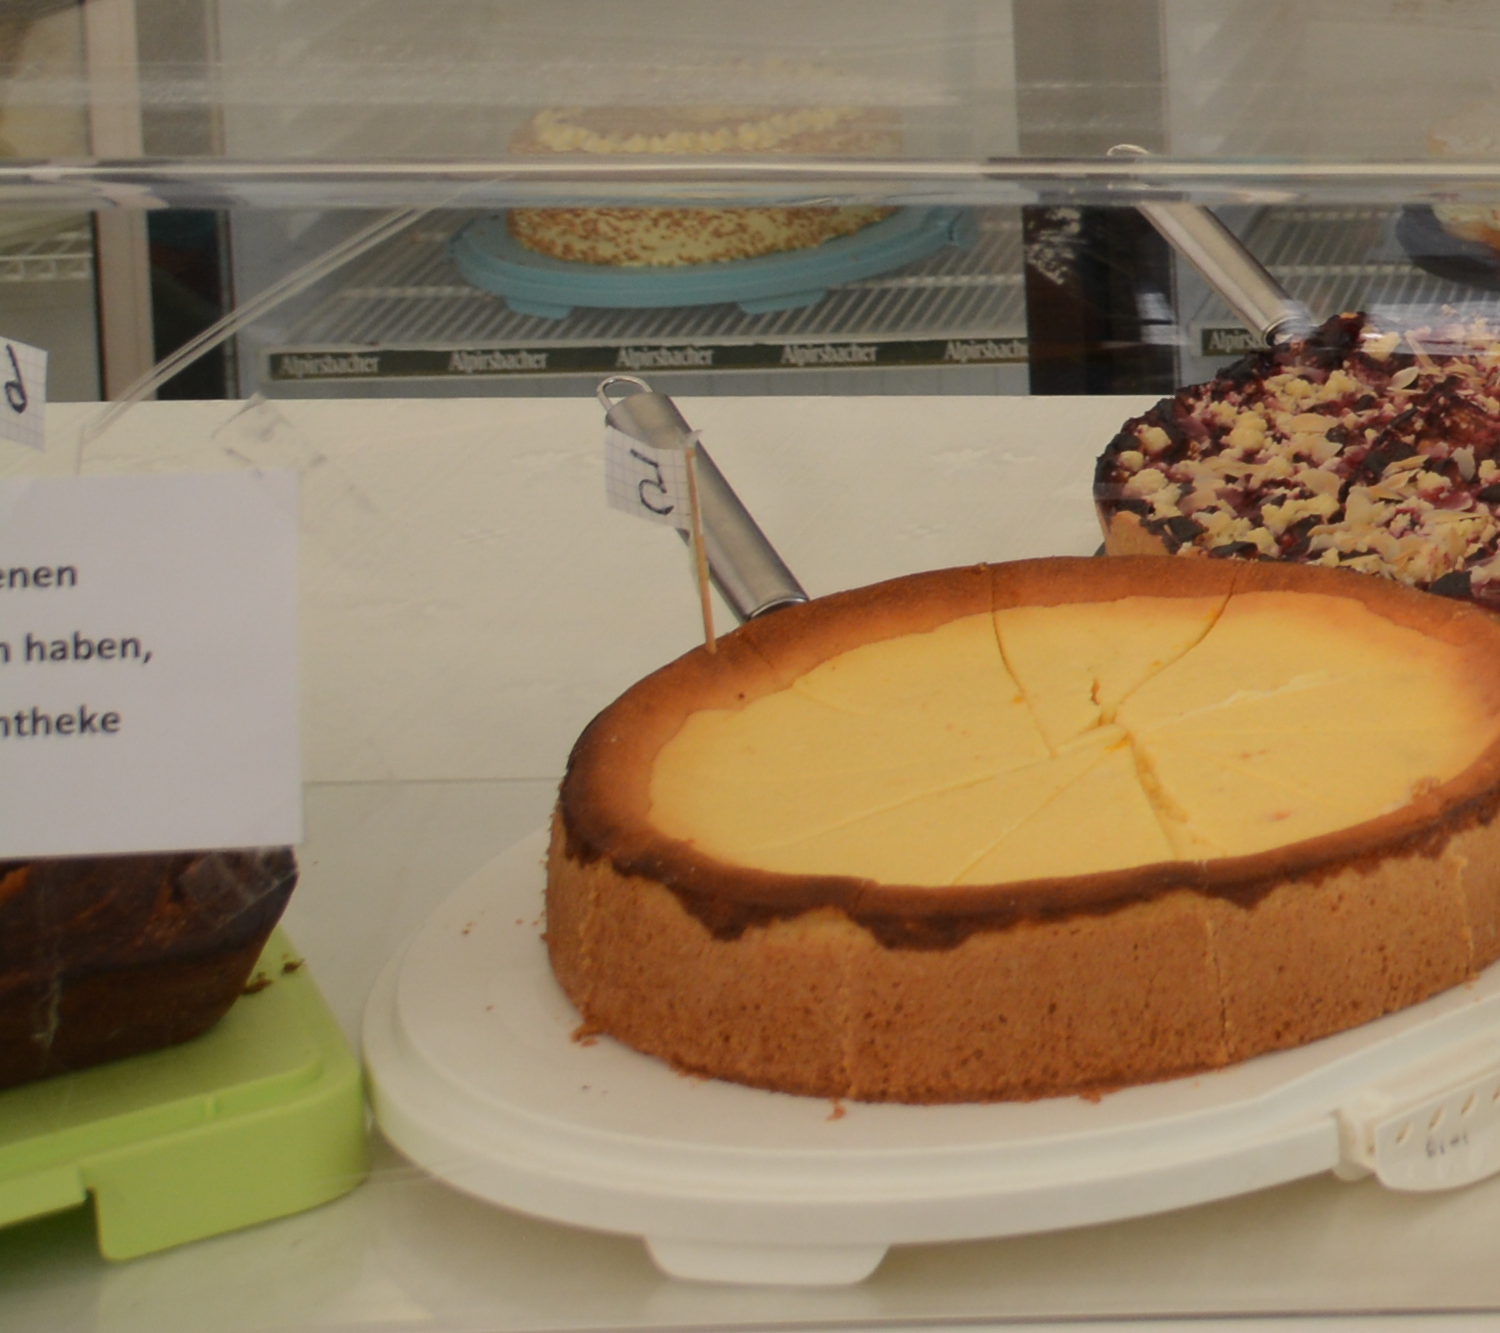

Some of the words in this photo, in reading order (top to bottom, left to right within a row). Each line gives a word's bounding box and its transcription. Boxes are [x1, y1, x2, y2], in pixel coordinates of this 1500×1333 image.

[278, 353, 379, 378] Alpirsbacher
[448, 350, 547, 374] Alpirsbacher
[615, 346, 714, 372] Alpirsbacher
[780, 344, 876, 367] Alpirsbacher
[24, 631, 154, 664] haben,
